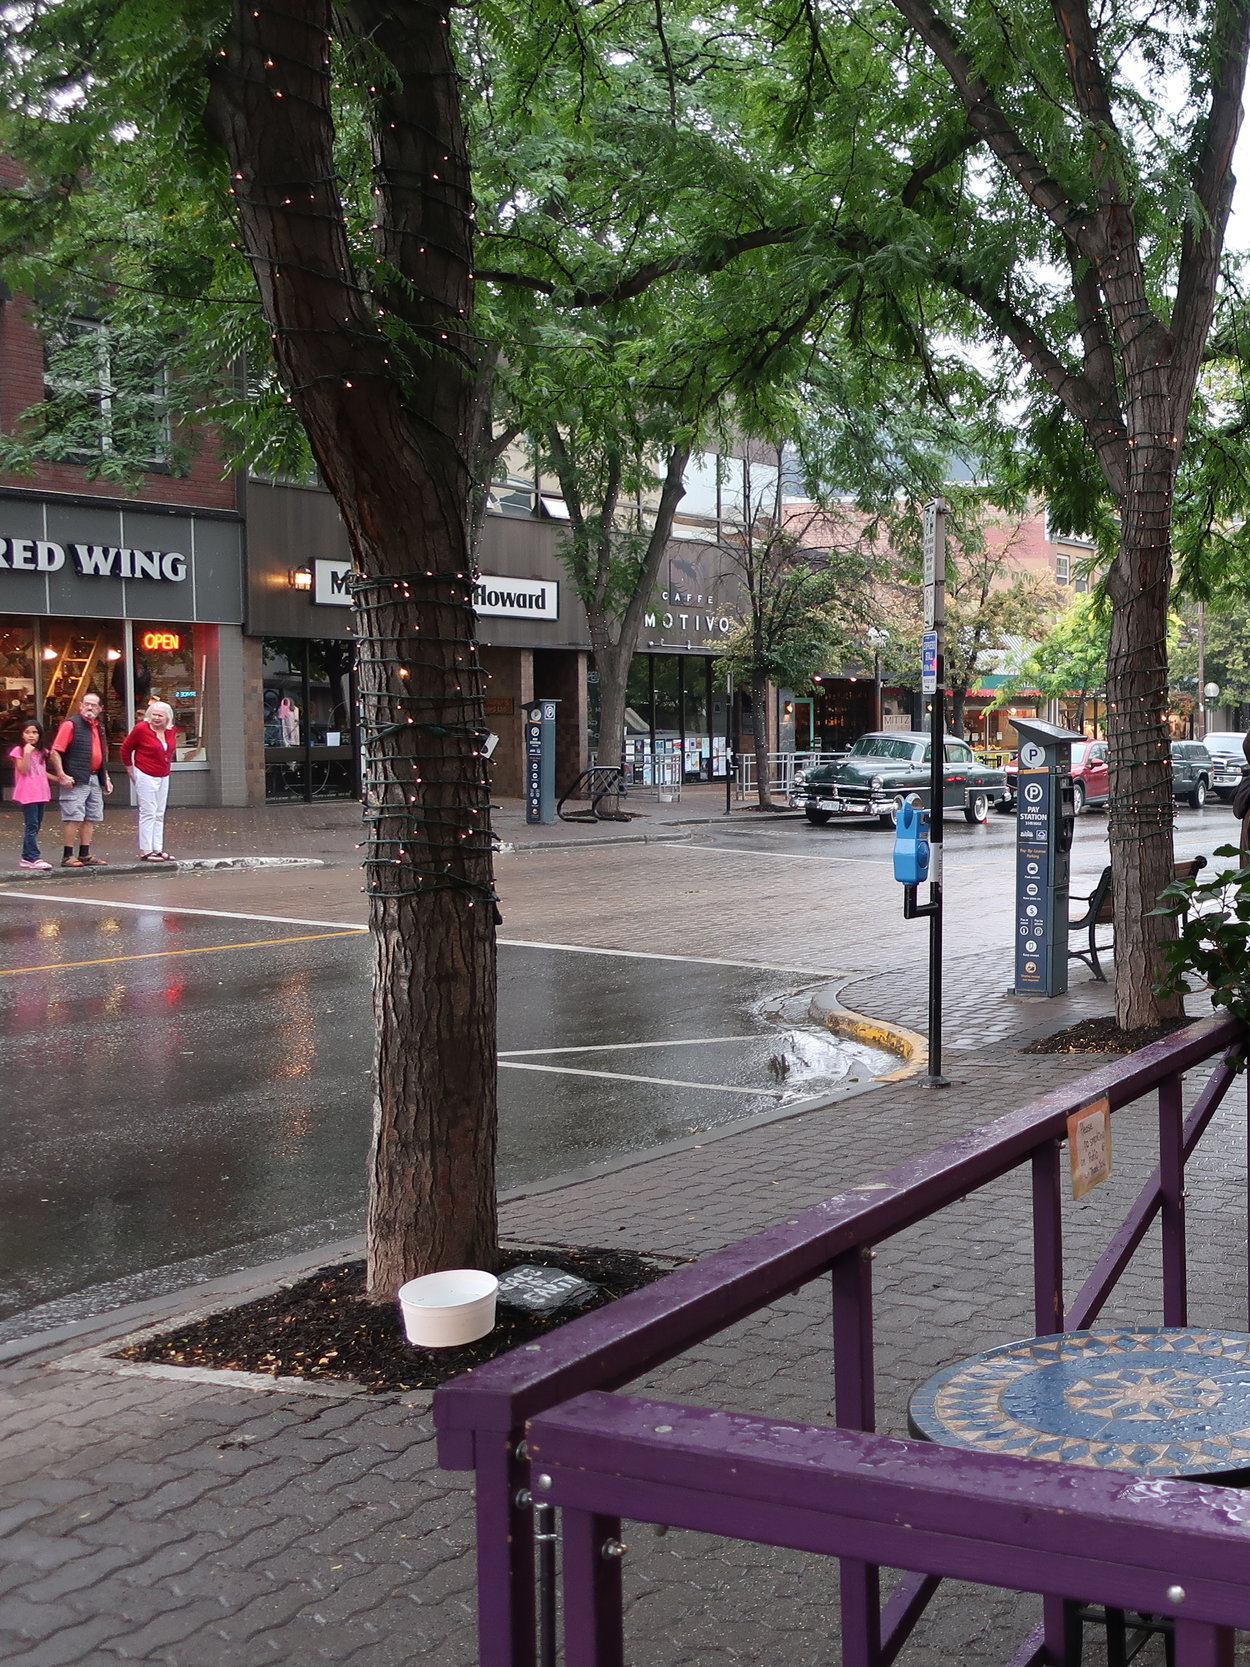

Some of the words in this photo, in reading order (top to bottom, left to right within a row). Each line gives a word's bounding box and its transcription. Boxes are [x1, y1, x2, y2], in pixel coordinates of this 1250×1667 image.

[74, 543, 188, 582] WING
[473, 584, 546, 610] Howard
[662, 591, 714, 604] CAFFE
[644, 612, 730, 632] MOTIVO
[144, 632, 180, 650] OPEN
[1020, 813, 1048, 821] STATION
